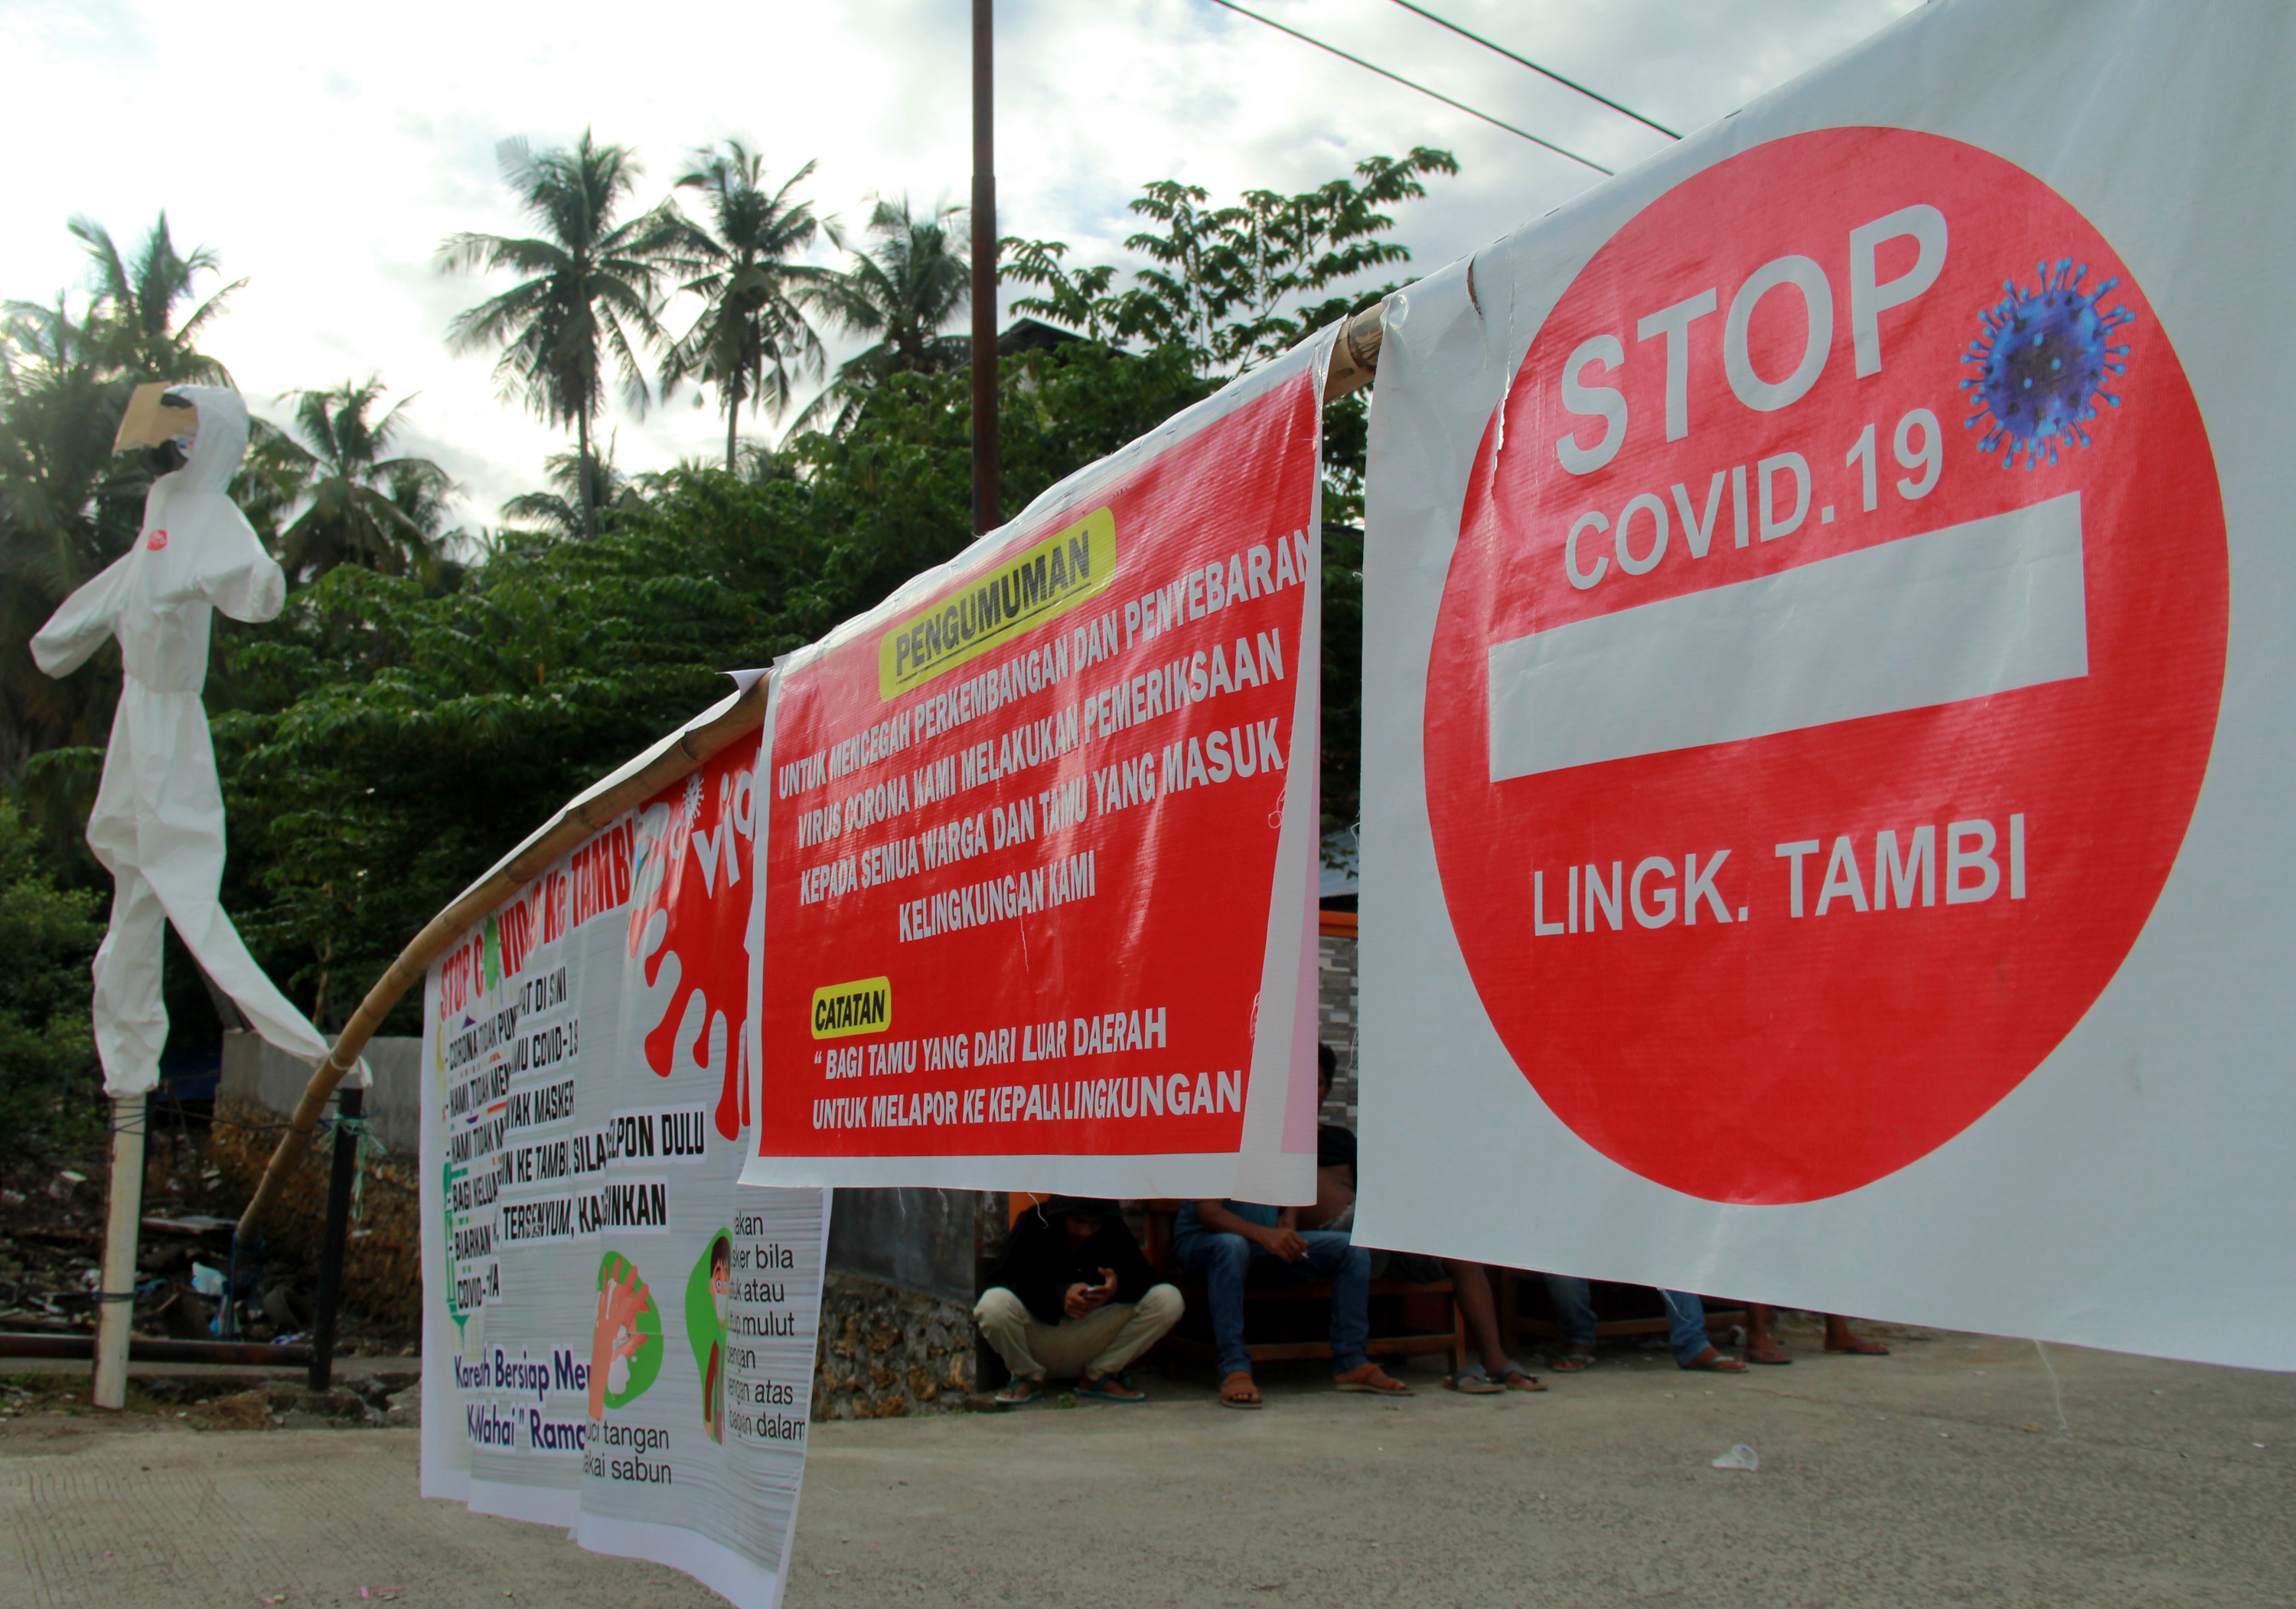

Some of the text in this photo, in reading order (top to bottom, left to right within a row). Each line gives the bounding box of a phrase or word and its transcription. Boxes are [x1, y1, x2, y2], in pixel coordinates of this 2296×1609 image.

[1554, 204, 1948, 476] STOP
[1564, 408, 1943, 591] COVID.19
[895, 531, 1091, 677] PENGUMUMAN
[778, 524, 1310, 800] UNTUK MENCEGAH PERKEMBANGAN DAN PENYEBARAN
[797, 628, 1284, 849] VIRUS CORONA KAMI MELAKUKAN PEMERIKSAAN
[800, 718, 1284, 906] KEPADA SEMUA WARGA DAN TAMU YANG MASUK
[899, 849, 1095, 943] KELINGKUNGAN KAMI
[1533, 813, 2026, 936] LINGK. TAMBI
[441, 944, 470, 1022] STOP
[544, 869, 567, 945] Ke
[572, 818, 634, 928] TAMBI
[536, 976, 546, 1012] DI
[550, 966, 566, 1008] SINI
[815, 989, 885, 1032] CATATAN
[533, 1019, 579, 1068] COVID-19
[825, 1041, 863, 1080] BAGI
[867, 1038, 918, 1077] TAMU
[921, 1033, 968, 1072] YANG
[974, 1026, 1016, 1065] DARI
[1022, 1021, 1067, 1062] LUAR
[1073, 1007, 1167, 1057] DAERAH
[536, 1080, 574, 1124] MASKER
[812, 1070, 1242, 1130] UNTUK MELAPOR KE KEPALA LINGKUNGAN
[517, 1148, 532, 1183] KE
[661, 1112, 705, 1155] DULU
[455, 1225, 491, 1261] BIARKAN
[756, 1243, 794, 1269] bila
[744, 1278, 784, 1302] atau
[743, 1311, 794, 1337] mulut
[495, 1349, 550, 1402] Bersiap
[755, 1379, 793, 1405] atas
[604, 1420, 670, 1454] tangan
[612, 1455, 672, 1484] sabun
